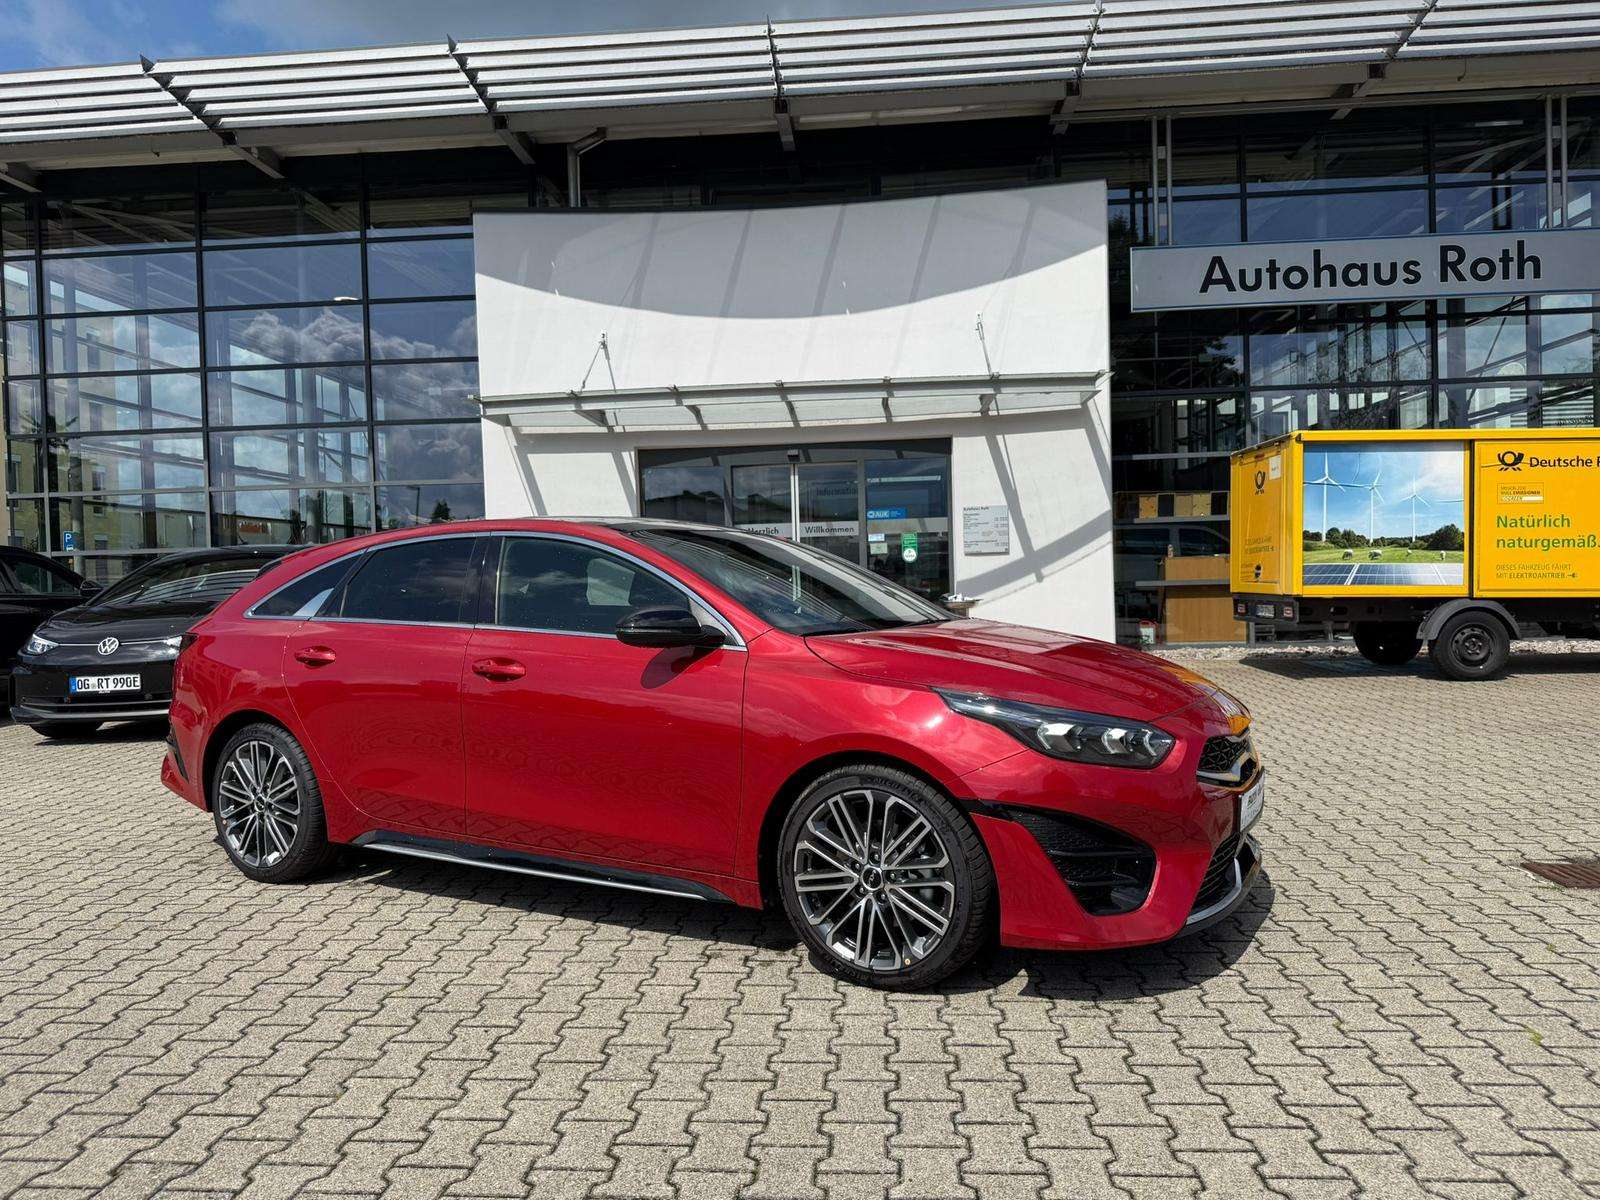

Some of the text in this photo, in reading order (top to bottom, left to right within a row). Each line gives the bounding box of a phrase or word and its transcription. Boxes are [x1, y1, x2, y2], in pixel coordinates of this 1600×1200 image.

[1199, 240, 1542, 294] Autohaus Roth
[1529, 456, 1593, 468] Deutsche
[1496, 514, 1571, 528] Natürlich
[804, 525, 855, 534] Willkommen
[1496, 563, 1516, 571] DIESES
[1518, 563, 1551, 571] FAHRZEUG
[77, 676, 139, 690] OG RT 990E
